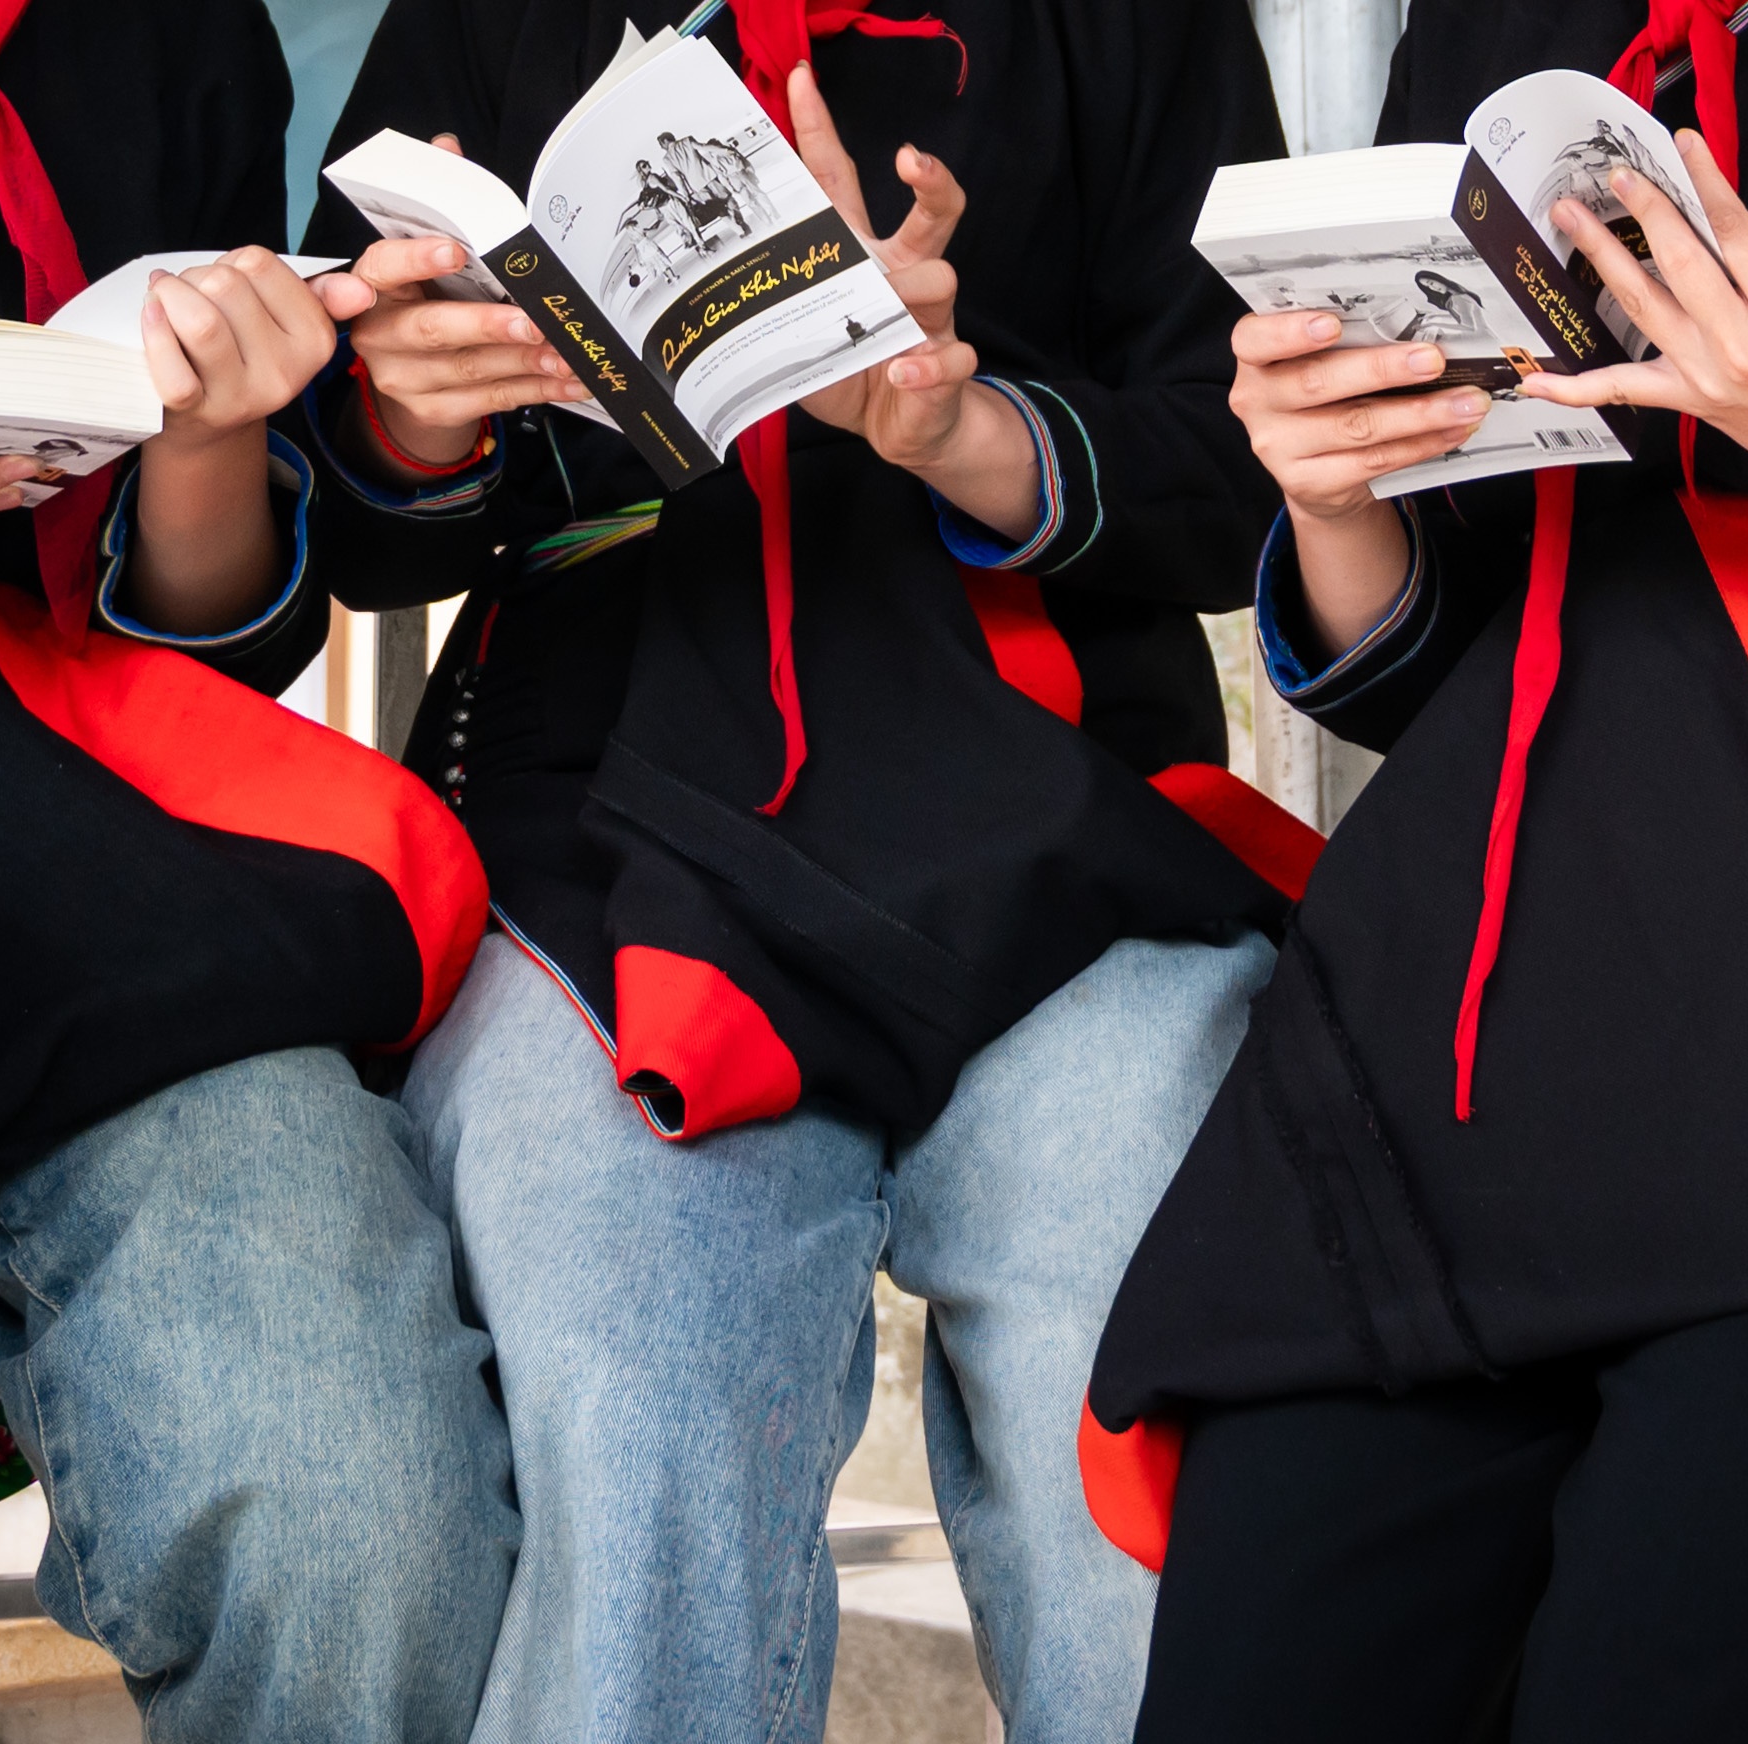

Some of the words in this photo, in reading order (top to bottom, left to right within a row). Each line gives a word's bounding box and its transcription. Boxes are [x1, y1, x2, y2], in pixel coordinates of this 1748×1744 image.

[564, 321, 584, 342] Gia
[662, 321, 704, 375] Quốc
[703, 302, 741, 327] Gia
[781, 241, 841, 280] Nghiệp
